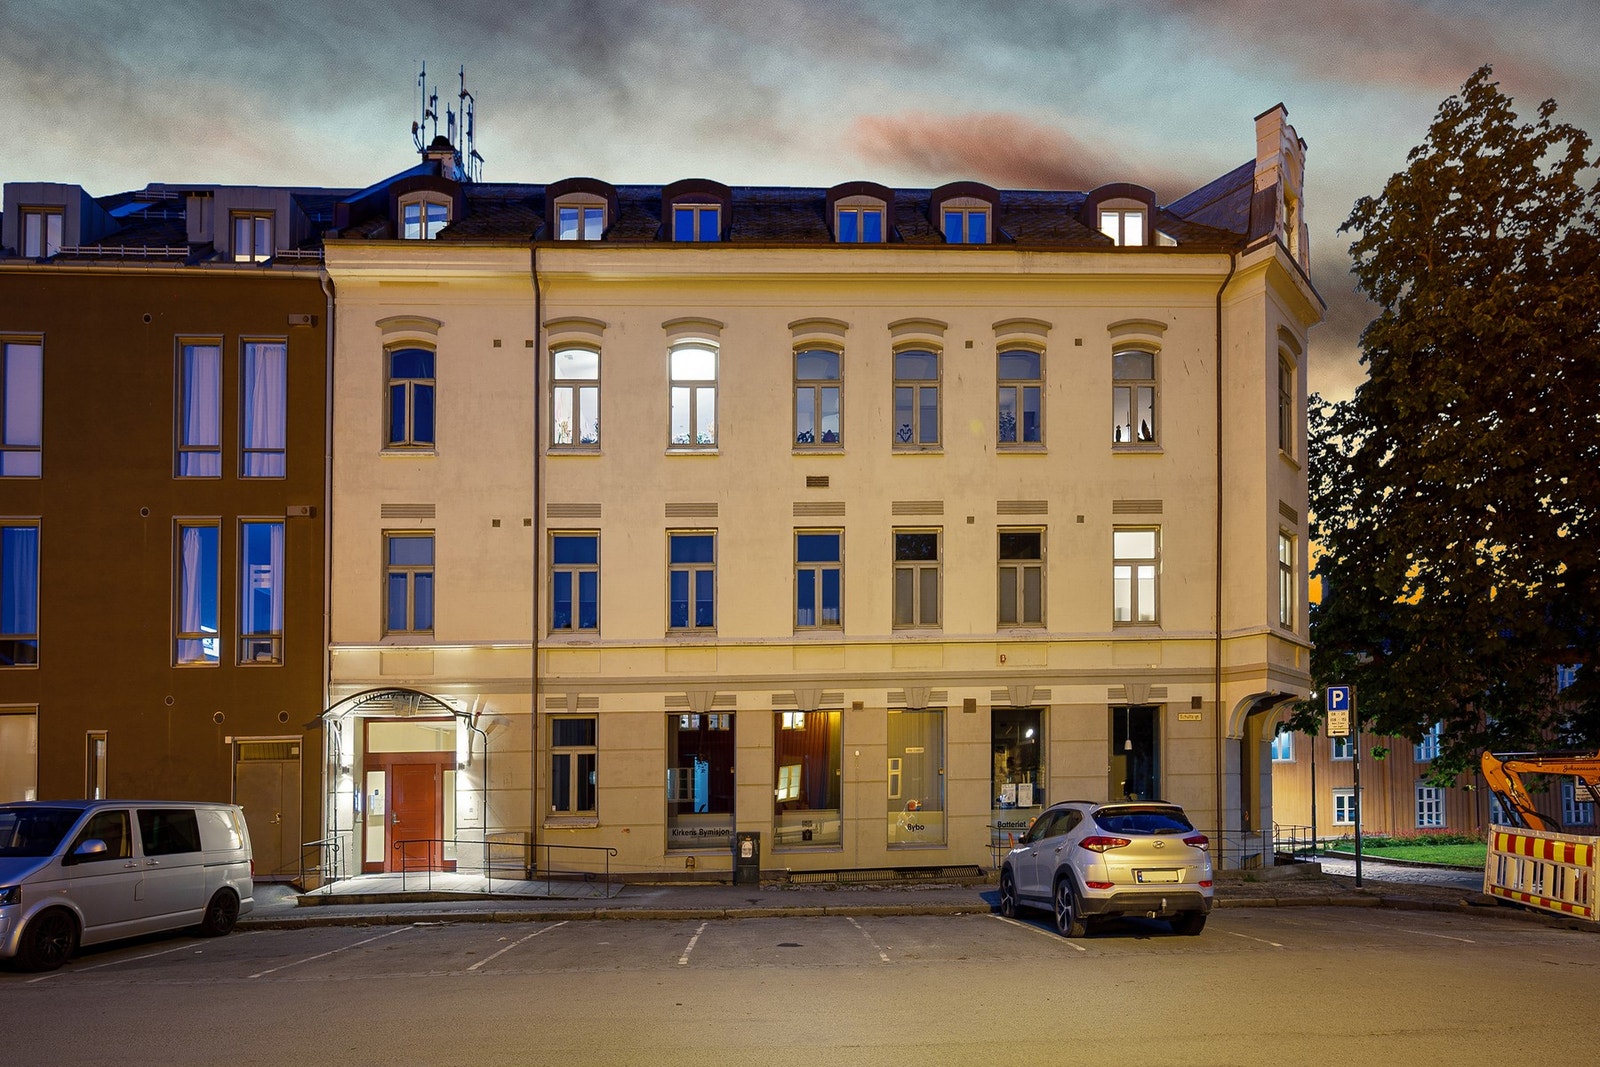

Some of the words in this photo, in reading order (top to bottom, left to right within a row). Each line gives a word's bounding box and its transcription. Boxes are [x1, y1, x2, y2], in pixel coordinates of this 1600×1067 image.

[1332, 690, 1344, 709] P
[907, 823, 925, 832] Bybo
[997, 820, 1027, 828] Batteriet
[672, 828, 697, 836] Kirkens
[699, 827, 730, 837] Bymisjon
